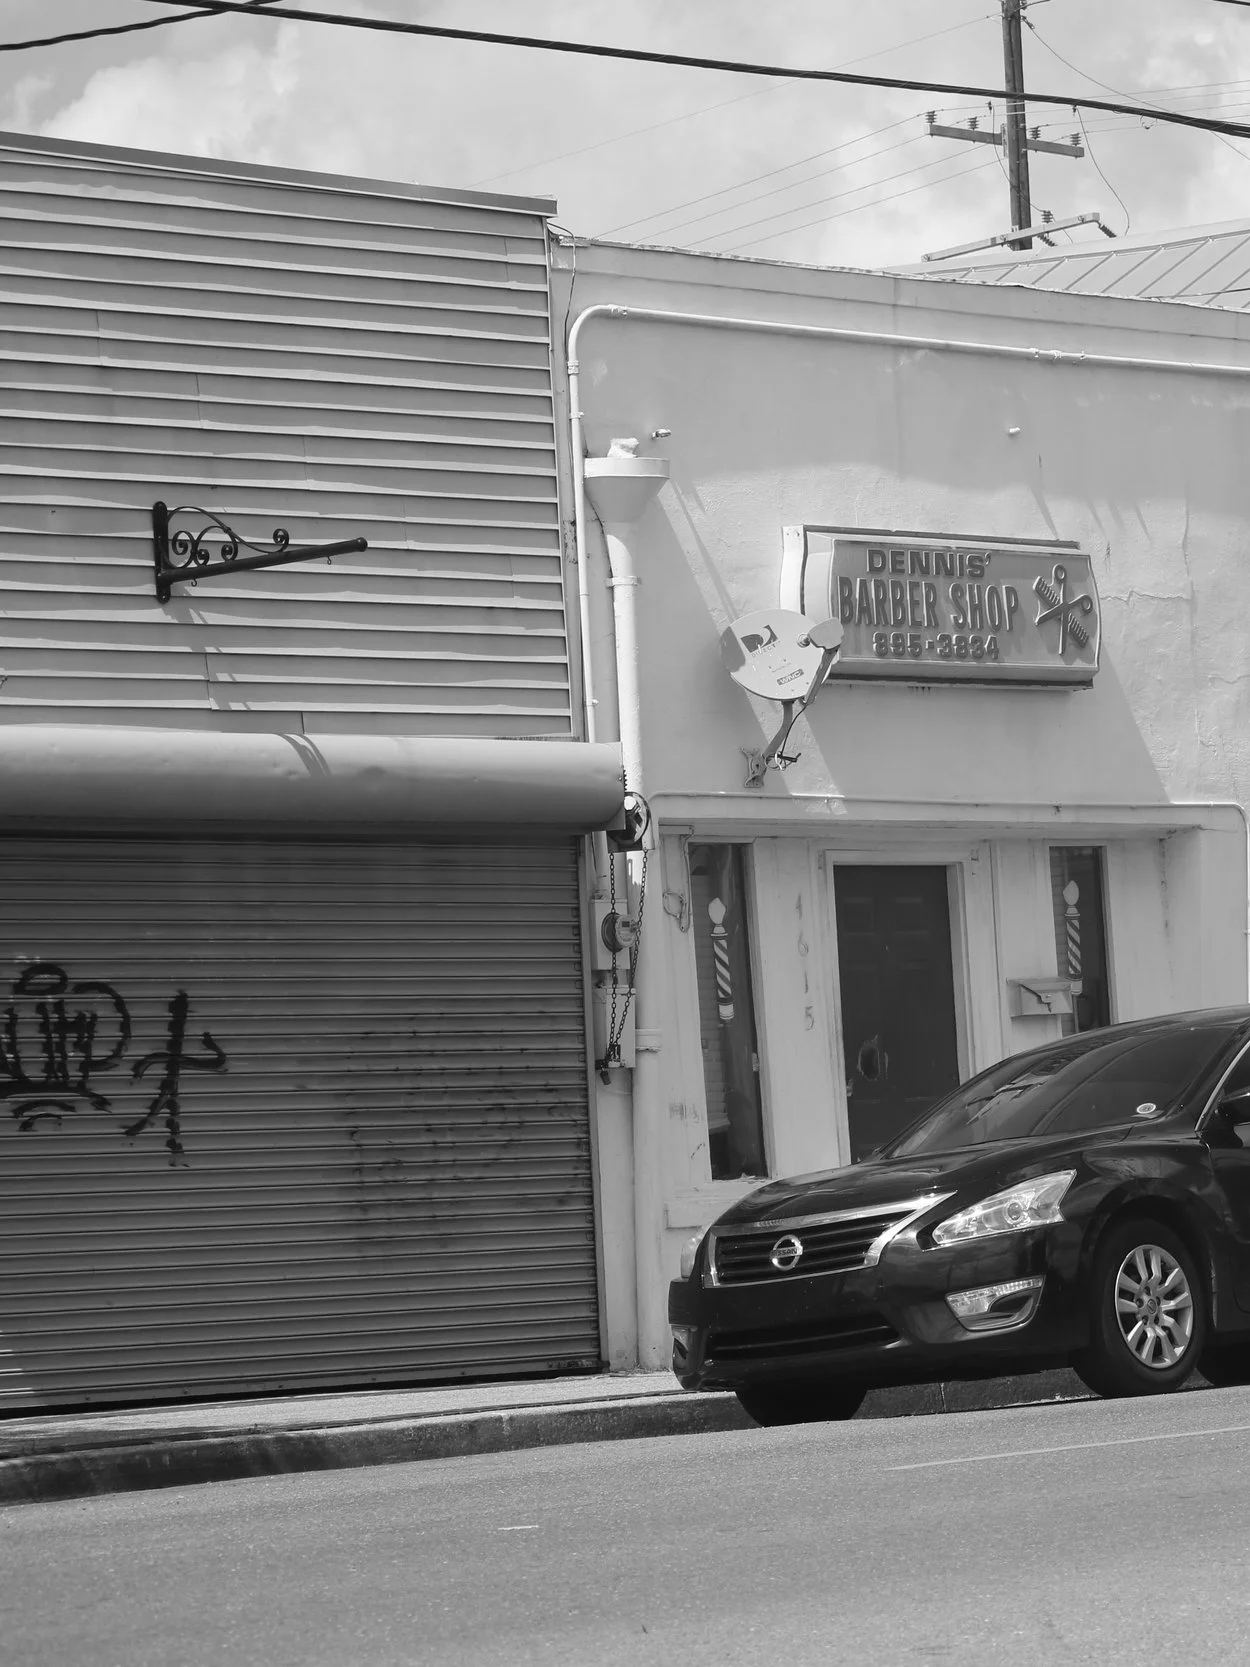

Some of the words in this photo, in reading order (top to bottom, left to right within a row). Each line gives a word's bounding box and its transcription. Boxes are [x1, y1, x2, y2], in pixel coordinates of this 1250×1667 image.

[867, 549, 991, 578] DENNIS'
[837, 575, 939, 627] BARBER
[949, 582, 1019, 632] SHOP
